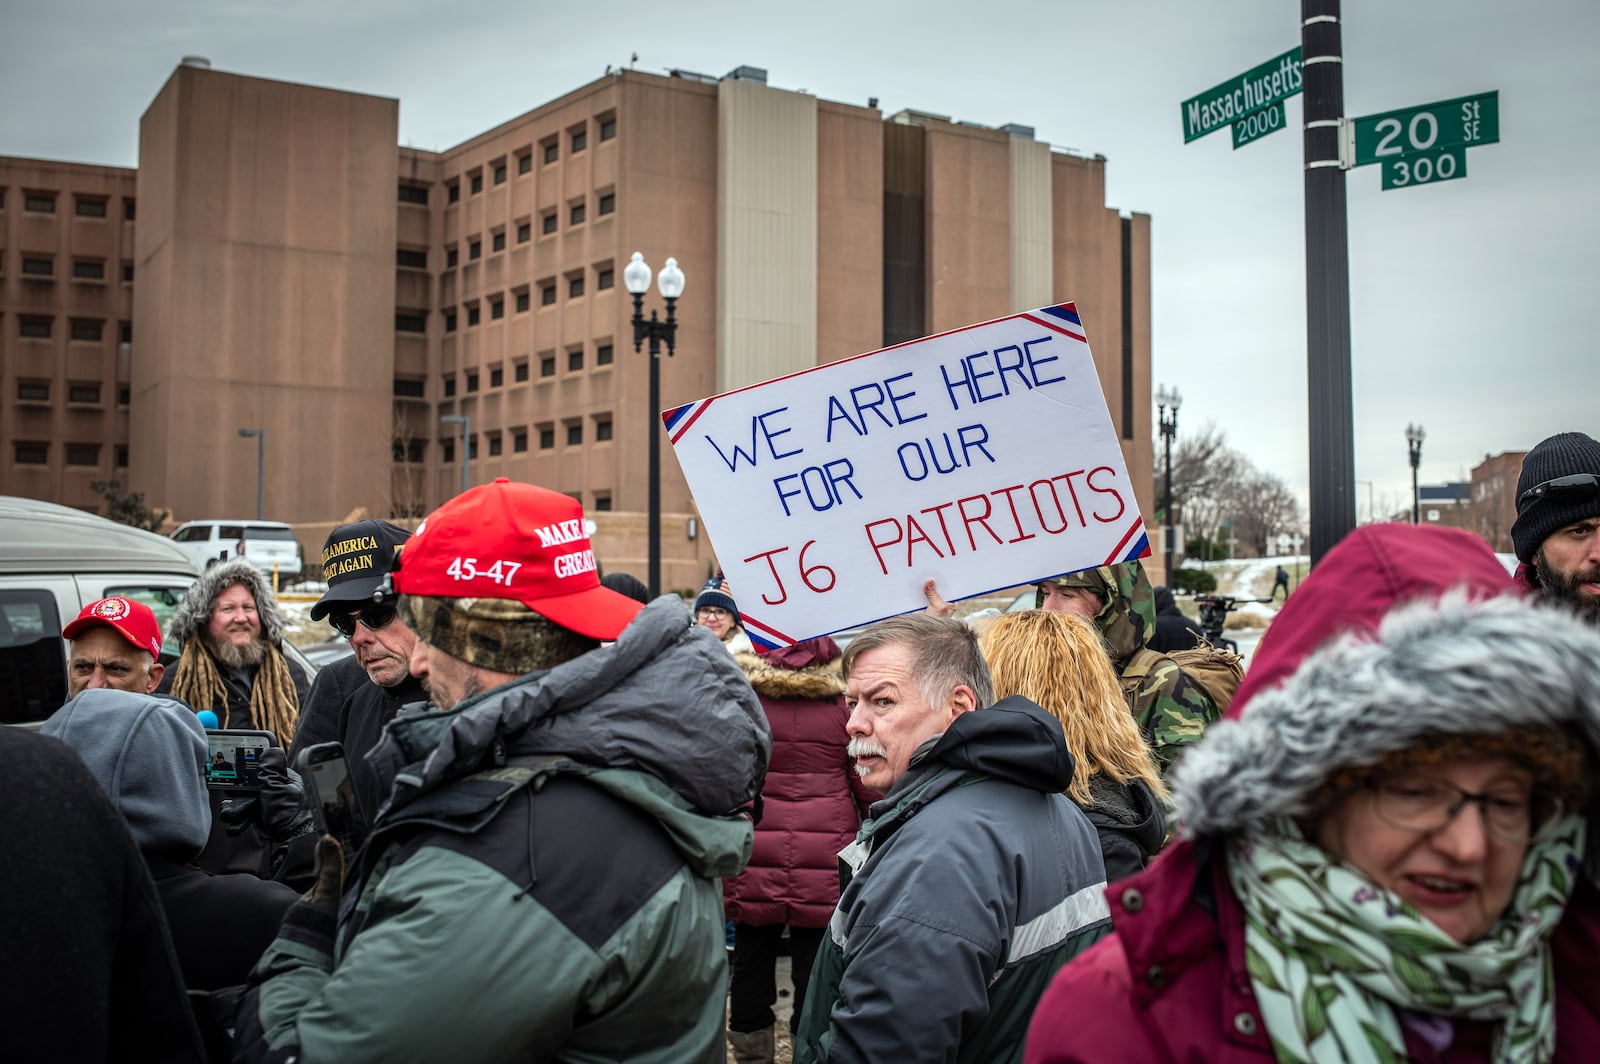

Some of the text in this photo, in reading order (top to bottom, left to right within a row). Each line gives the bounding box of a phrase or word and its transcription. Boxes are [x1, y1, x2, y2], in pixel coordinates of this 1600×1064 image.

[1188, 56, 1302, 135] Massachusetts
[1237, 106, 1279, 142] 2000
[1374, 101, 1480, 157] 20 St
[1463, 120, 1480, 141] SE
[1392, 154, 1456, 185] 300
[705, 336, 1066, 472] WE ARE HERE
[773, 458, 863, 517] FOR
[329, 536, 378, 558] AMERICA
[534, 518, 581, 548] MAKE
[743, 466, 1125, 606] J6 PATRIOTS
[338, 554, 373, 575] AGAIN
